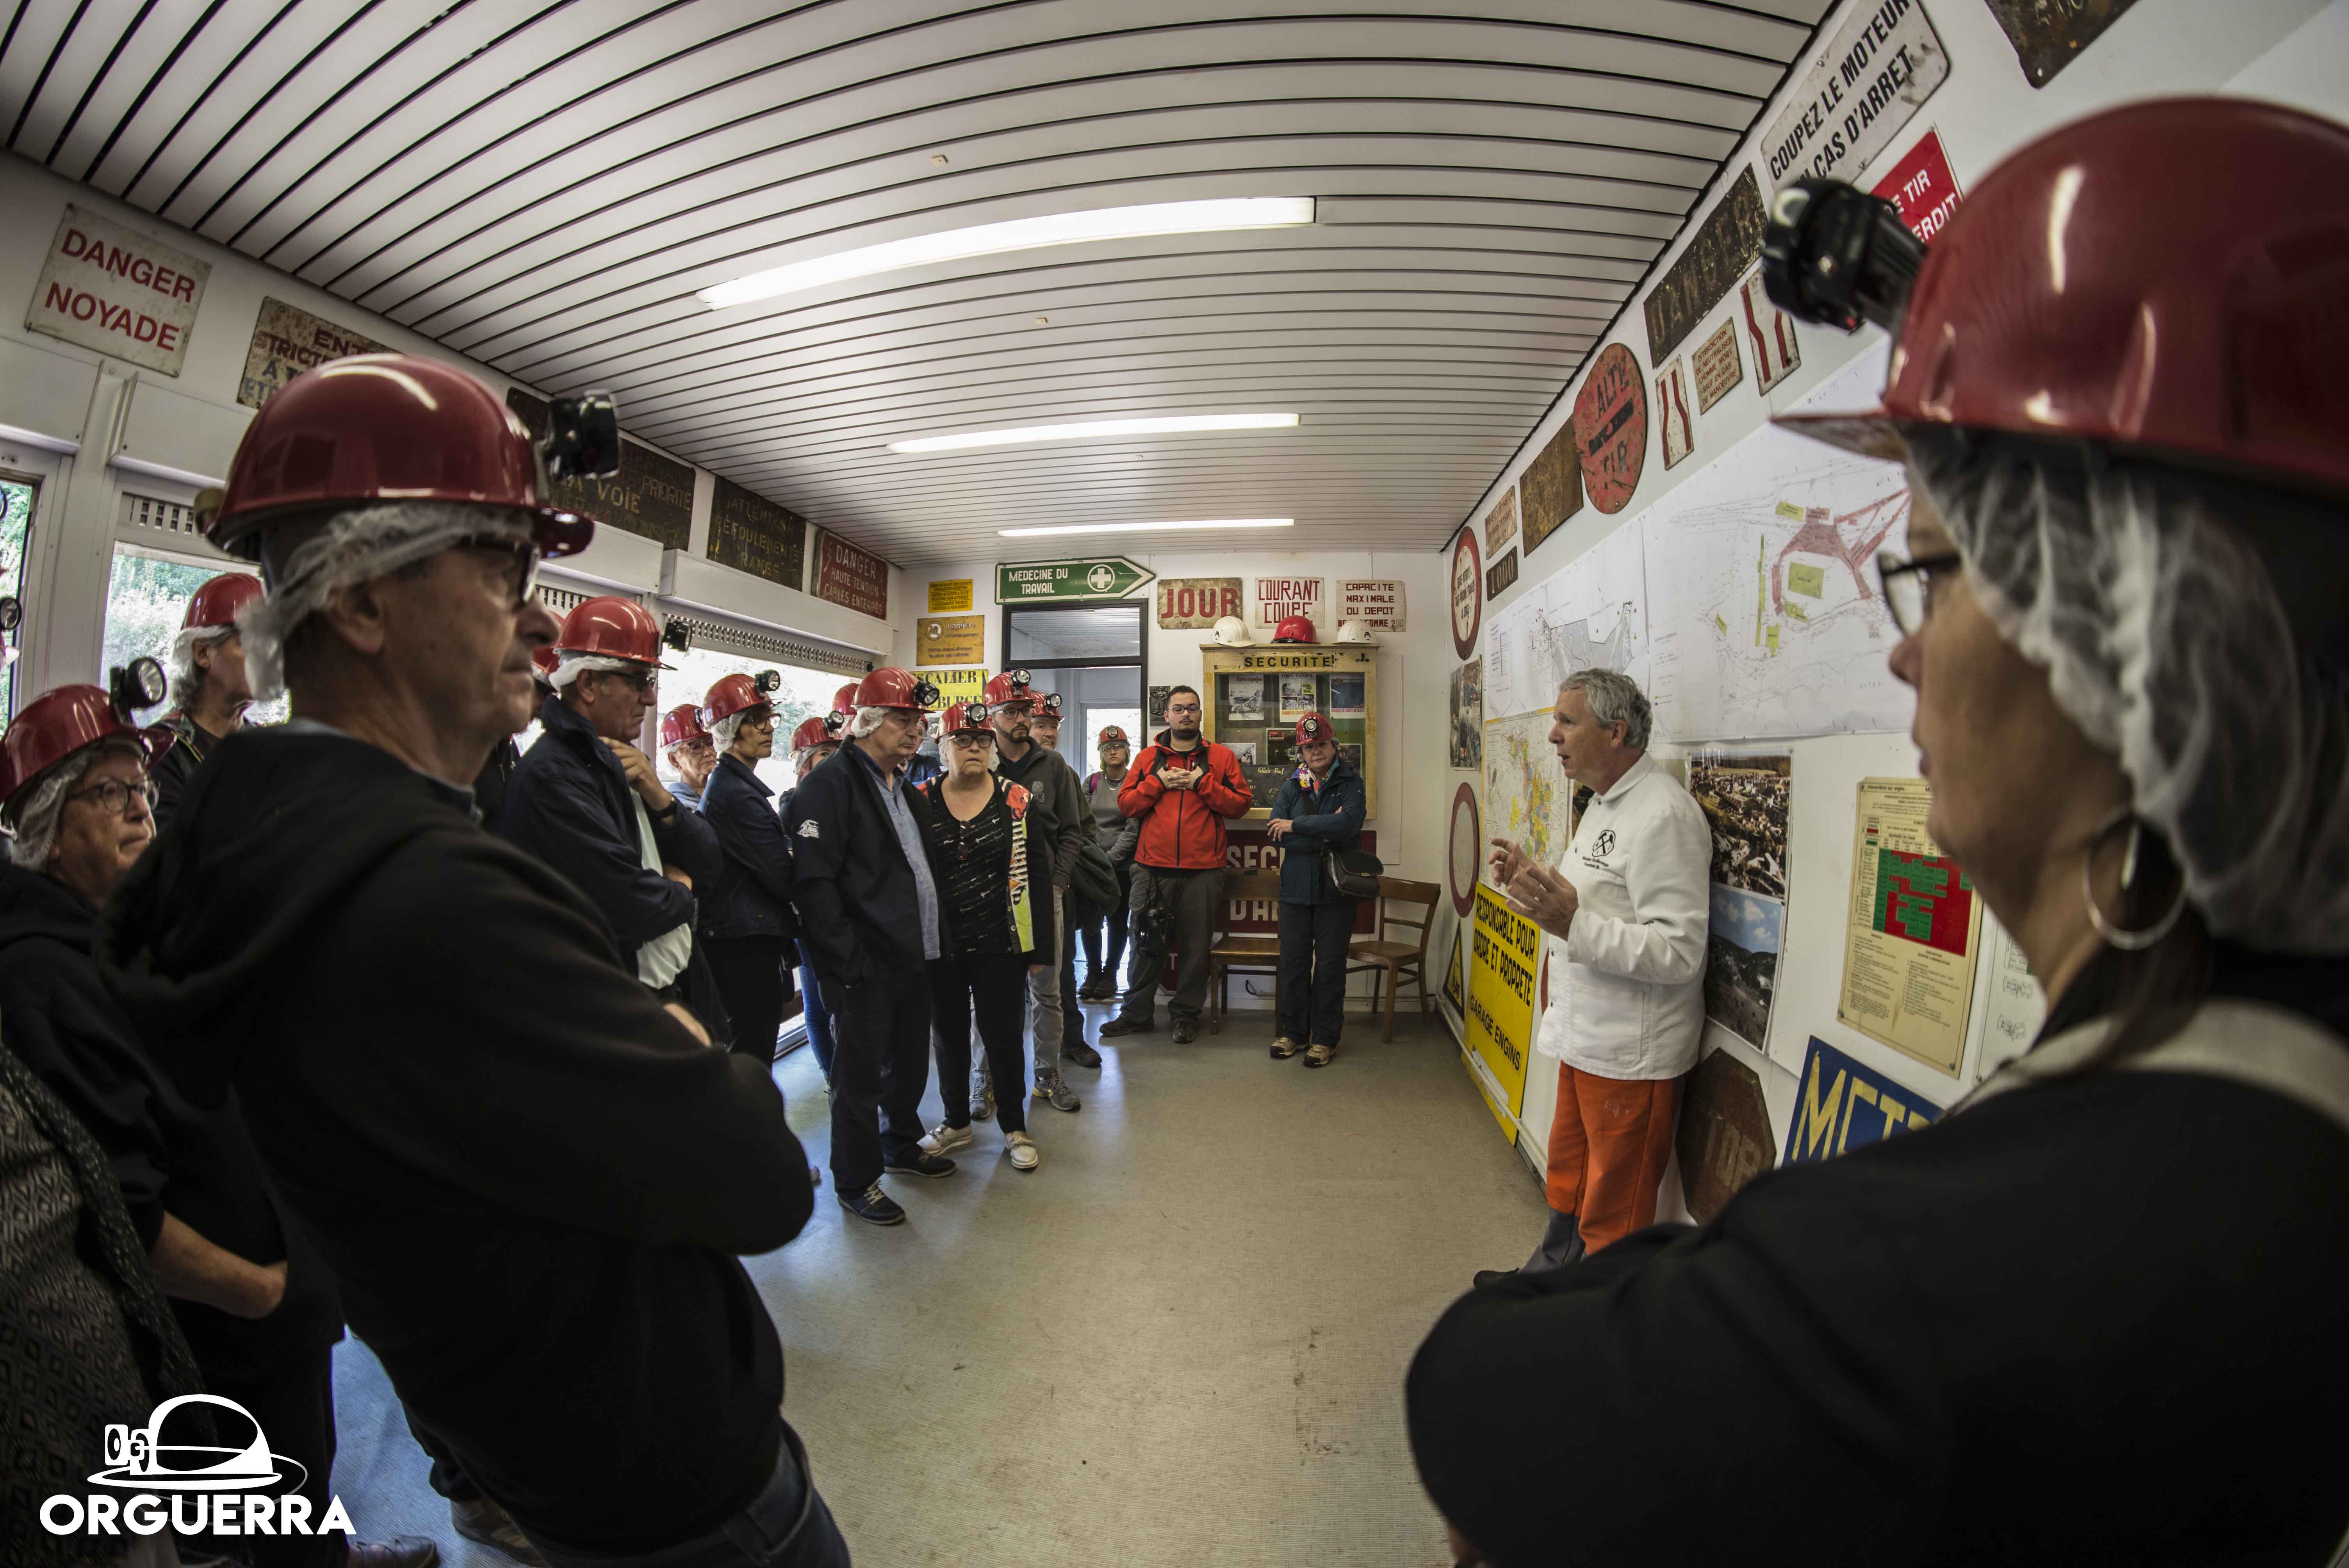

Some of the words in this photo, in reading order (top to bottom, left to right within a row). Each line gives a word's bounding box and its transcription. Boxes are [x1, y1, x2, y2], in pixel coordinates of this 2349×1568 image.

[1770, 101, 1824, 180] COUPEZ
[1821, 76, 1844, 114] LE
[1814, 132, 1846, 180] CAS
[1844, 44, 1914, 144] D'ARRET
[1903, 169, 1931, 203] TIR
[61, 228, 196, 303] DANGER
[45, 282, 180, 352] NOYADE
[1698, 329, 1727, 361] INTERDICTION
[1703, 336, 1733, 369] NEUTRALISER
[1703, 378, 1713, 394] SAUF
[1715, 372, 1721, 382] EN
[1722, 362, 1732, 376] CAS
[1702, 396, 1708, 406] DE
[836, 545, 876, 579] DANGER
[1009, 569, 1053, 582] MEDECINE
[1056, 568, 1068, 579] DU
[1491, 555, 1514, 594] 1000
[1021, 583, 1055, 594] TRAVAIL
[1161, 588, 1237, 619] JOUR
[1258, 580, 1320, 601] COURANT
[1244, 657, 1331, 667] SECURITE
[1476, 892, 1515, 946] RESPONSABLE
[1516, 919, 1536, 962] POUR
[1474, 927, 1490, 966] ORDRE
[1491, 942, 1499, 973] ET
[1500, 950, 1533, 1007] PROPRETE
[1470, 994, 1494, 1037] GARAGE
[1494, 1025, 1521, 1071] ENGINS
